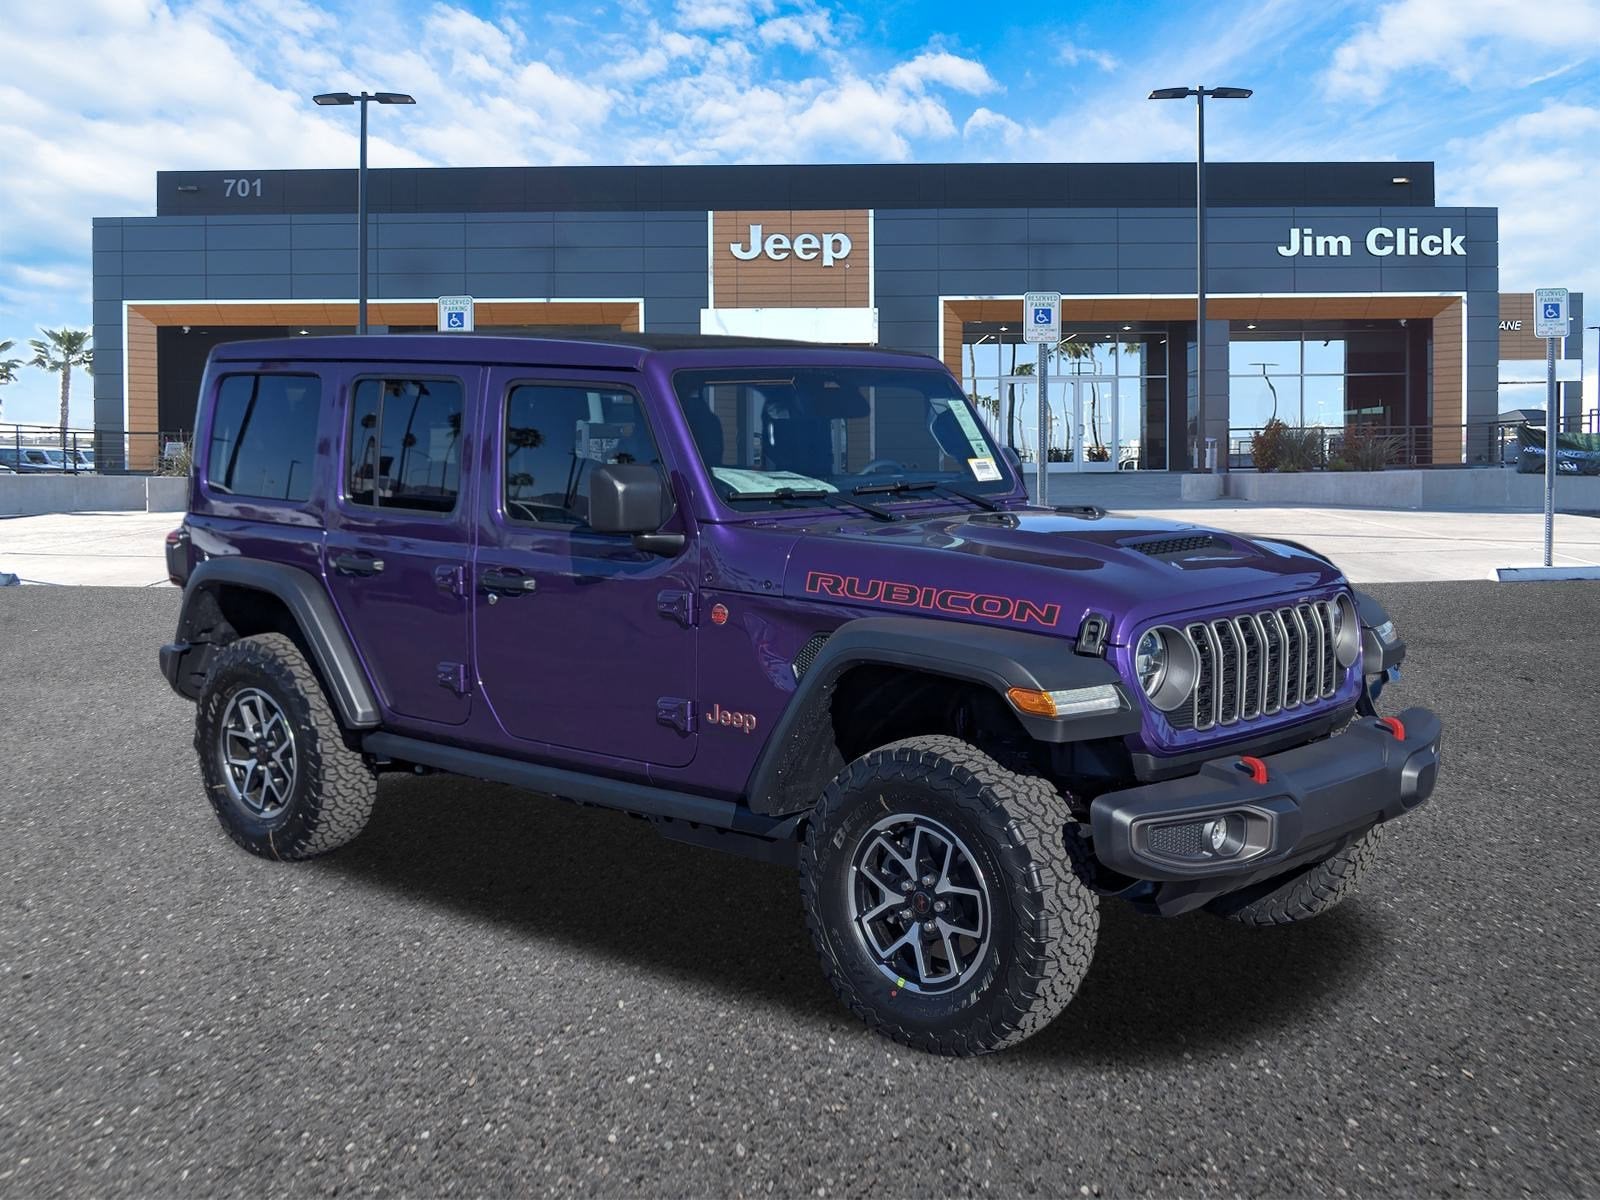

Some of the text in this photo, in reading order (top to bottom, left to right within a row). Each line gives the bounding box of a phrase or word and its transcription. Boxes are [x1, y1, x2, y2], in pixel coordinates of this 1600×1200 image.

[223, 178, 261, 197] 701
[729, 223, 852, 267] Jeep
[1277, 227, 1467, 257] Jim Click
[805, 571, 1062, 627] RUBICON
[705, 703, 757, 733] Jeep
